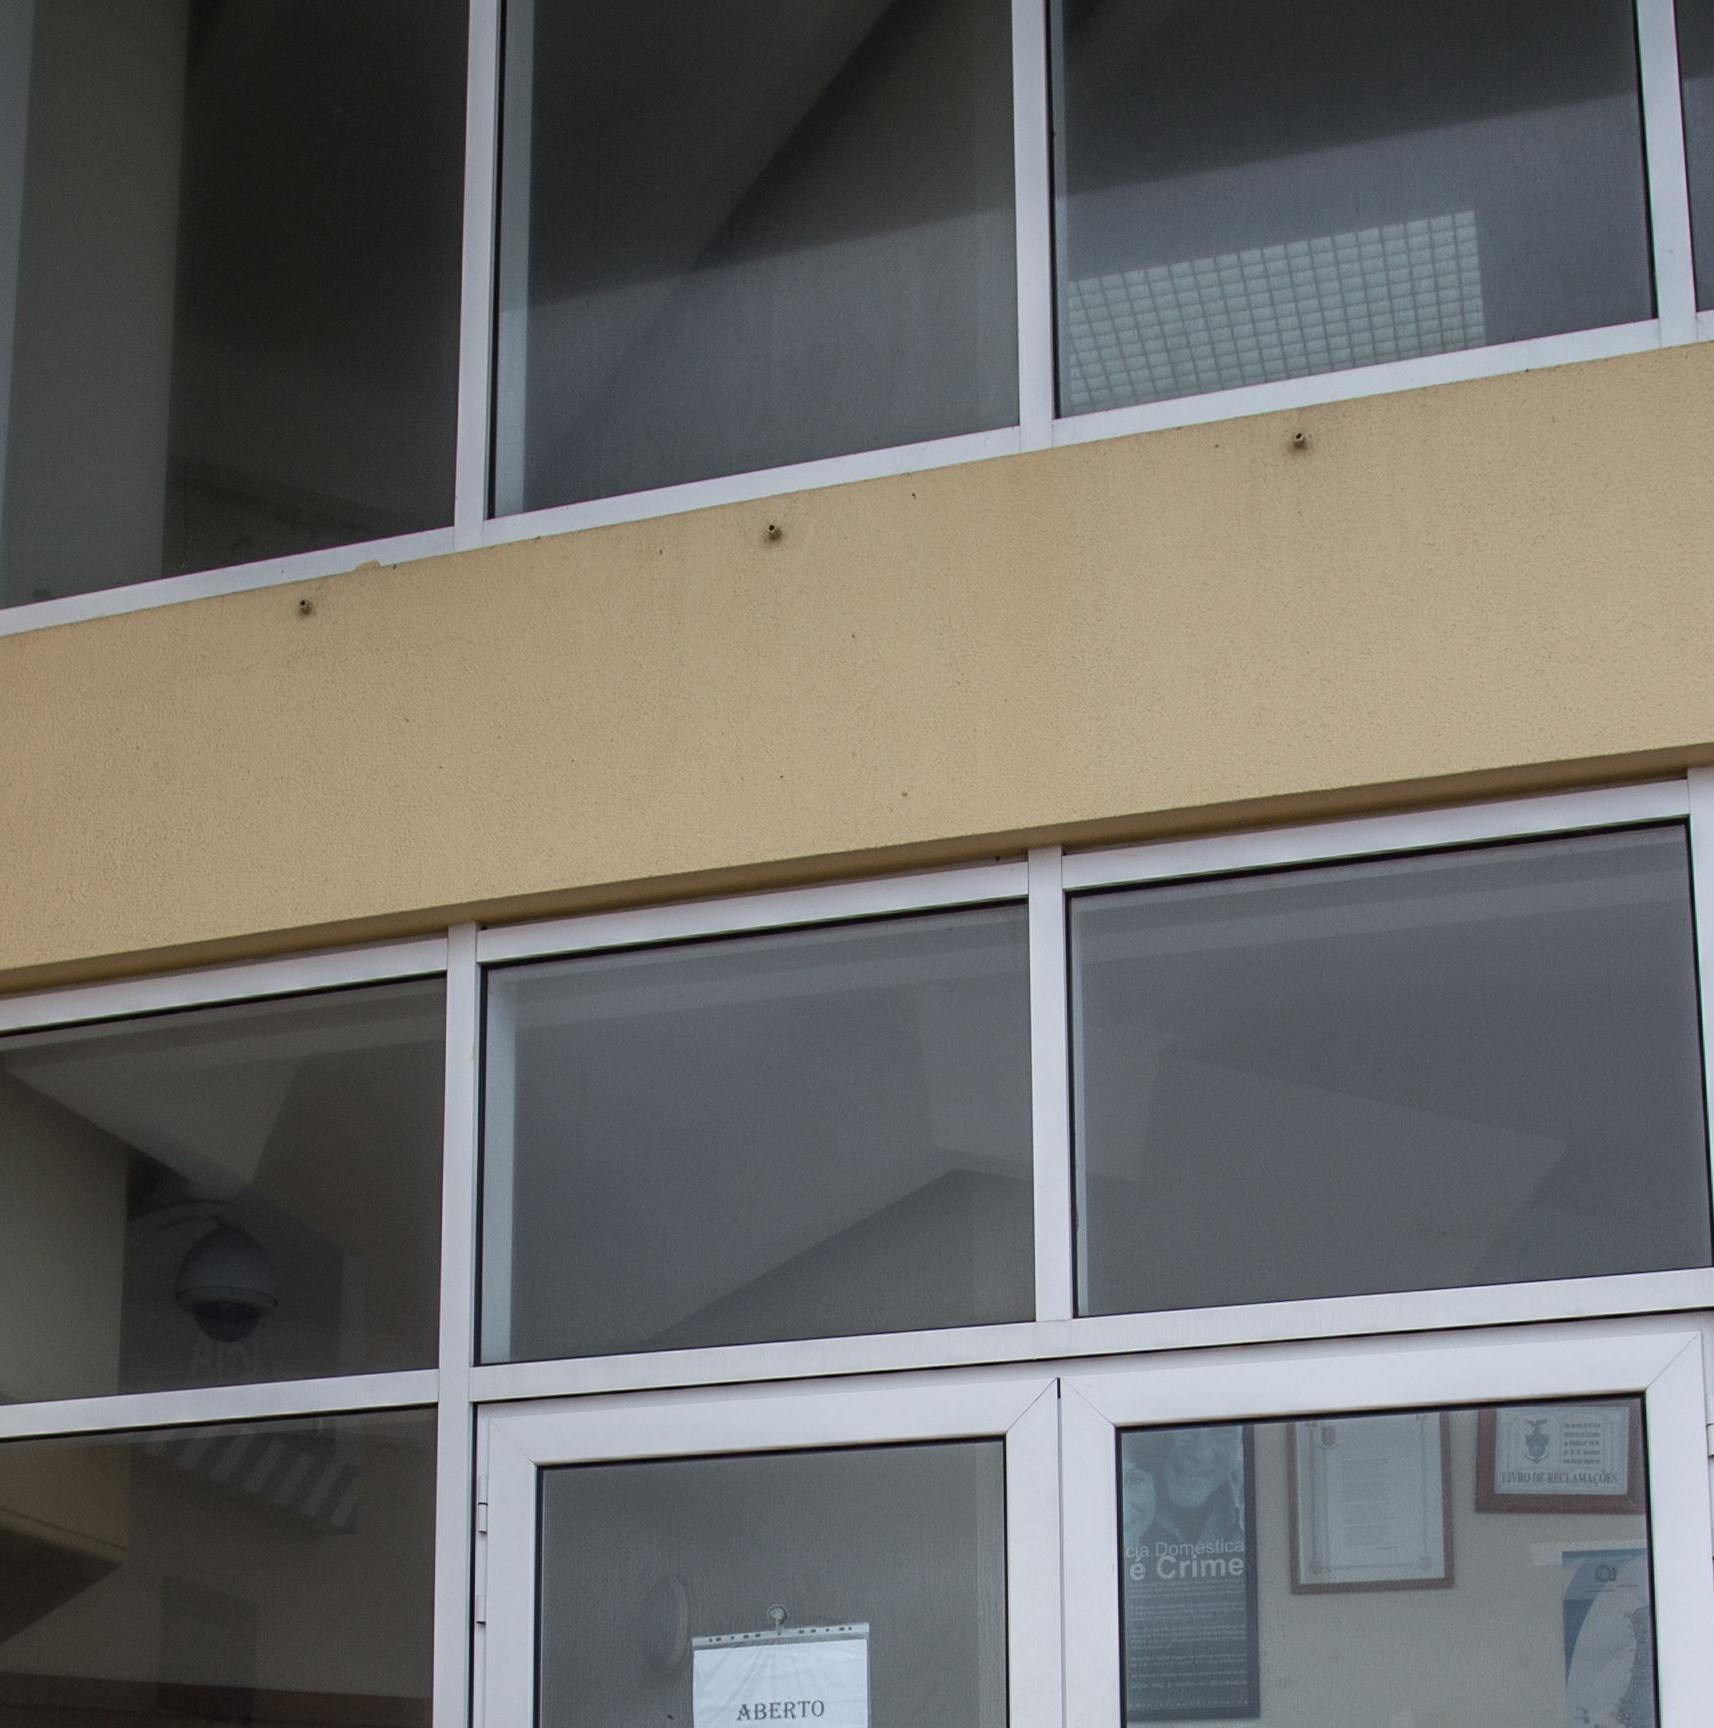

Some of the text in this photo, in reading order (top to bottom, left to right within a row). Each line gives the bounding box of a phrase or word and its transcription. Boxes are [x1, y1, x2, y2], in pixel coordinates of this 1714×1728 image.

[1501, 1470, 1531, 1484] LIVRO
[1533, 1471, 1547, 1484] DE
[1155, 1537, 1245, 1556] Doméstica
[1157, 1554, 1245, 1579] Crime
[737, 1700, 825, 1721] ABERTO
